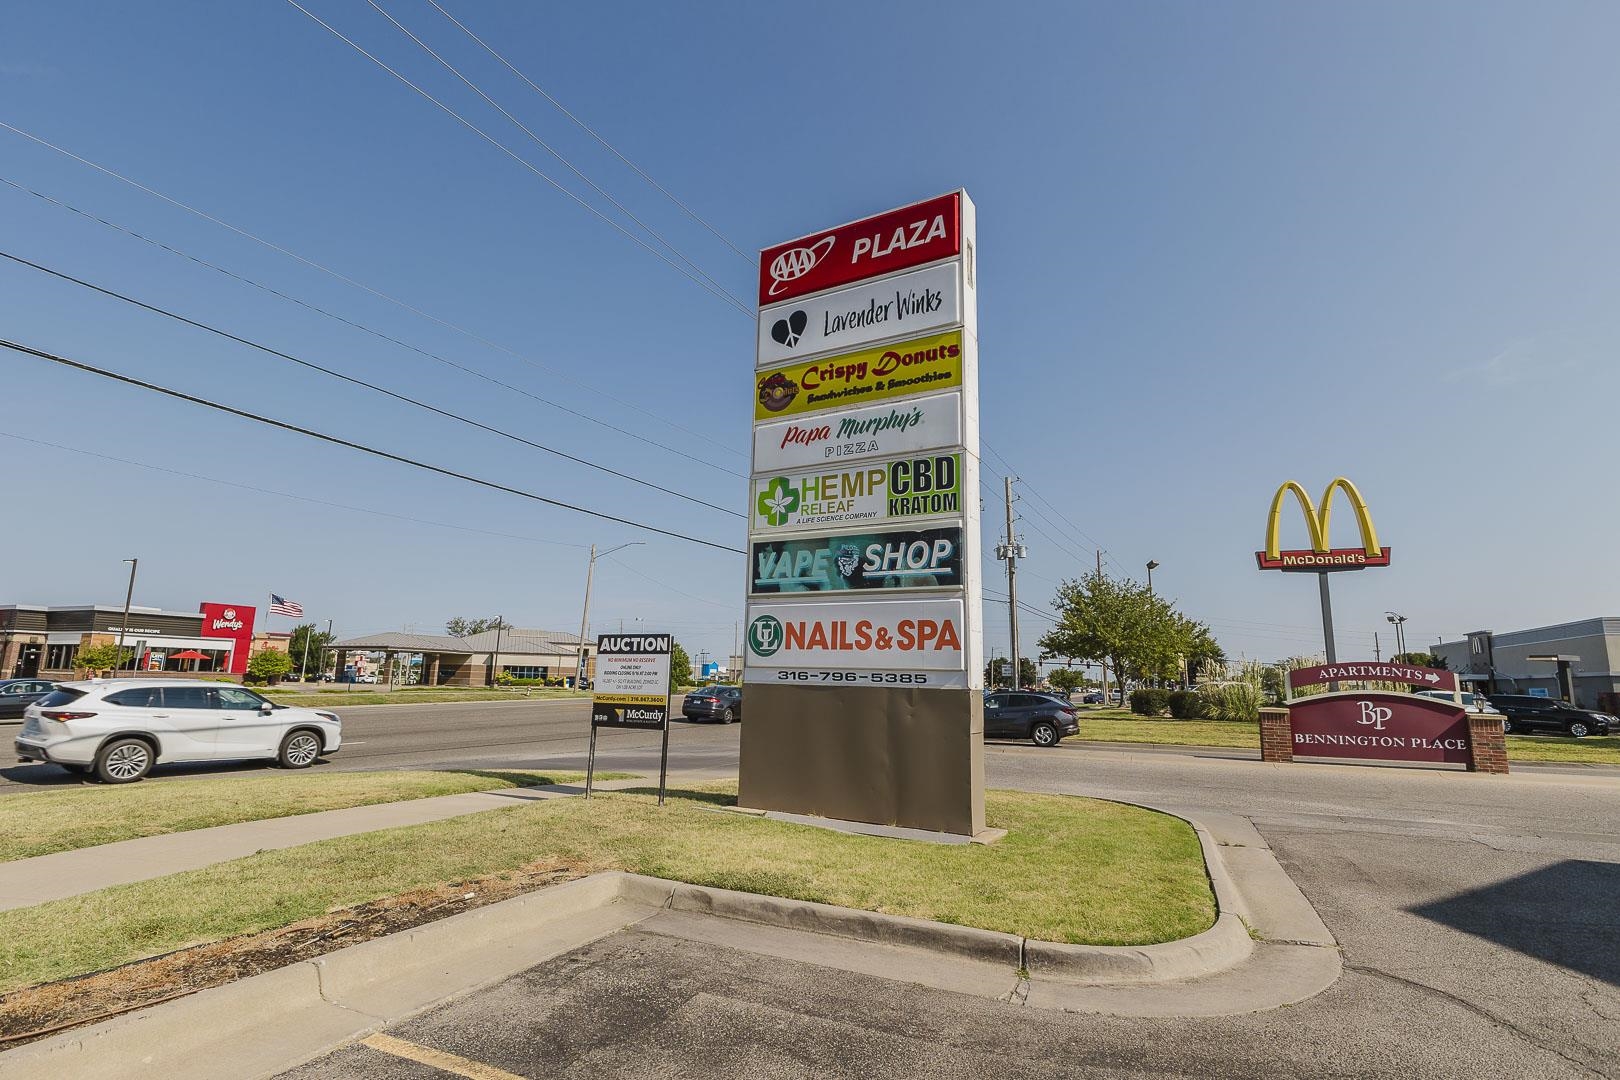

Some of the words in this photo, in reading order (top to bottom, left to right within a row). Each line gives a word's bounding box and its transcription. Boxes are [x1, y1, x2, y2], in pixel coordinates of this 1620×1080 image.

[851, 214, 947, 264] PLAZA
[776, 249, 810, 279] AAA
[824, 298, 894, 337] Lavender
[896, 288, 942, 321] Winks
[801, 361, 868, 390] Crispy
[871, 343, 960, 377] Donuts
[807, 385, 873, 404] Sandwiches
[875, 381, 885, 391] &
[887, 371, 952, 390] Smoothies
[781, 425, 832, 449] Papa
[836, 407, 925, 439] Murphy's
[825, 440, 879, 457] PIZZA
[802, 468, 886, 502] HEMP
[891, 456, 955, 495] CBD
[801, 500, 854, 516] RELEAF
[889, 493, 957, 516] KRATOM
[816, 515, 843, 523] SCIENCE
[844, 511, 877, 520] COMPANY
[758, 548, 832, 579] VAPE
[862, 539, 953, 571] SHOP
[1283, 554, 1366, 566] McDonald's
[212, 618, 243, 631] Wendy's
[600, 637, 668, 652] AUCTION
[777, 670, 927, 684] 316-796-5385
[1319, 666, 1423, 680] APARTMENTS
[626, 709, 663, 721] McCurdy
[1356, 701, 1392, 730] BP
[1295, 733, 1405, 747] BENNINGTON
[1411, 737, 1466, 750] PLACE
